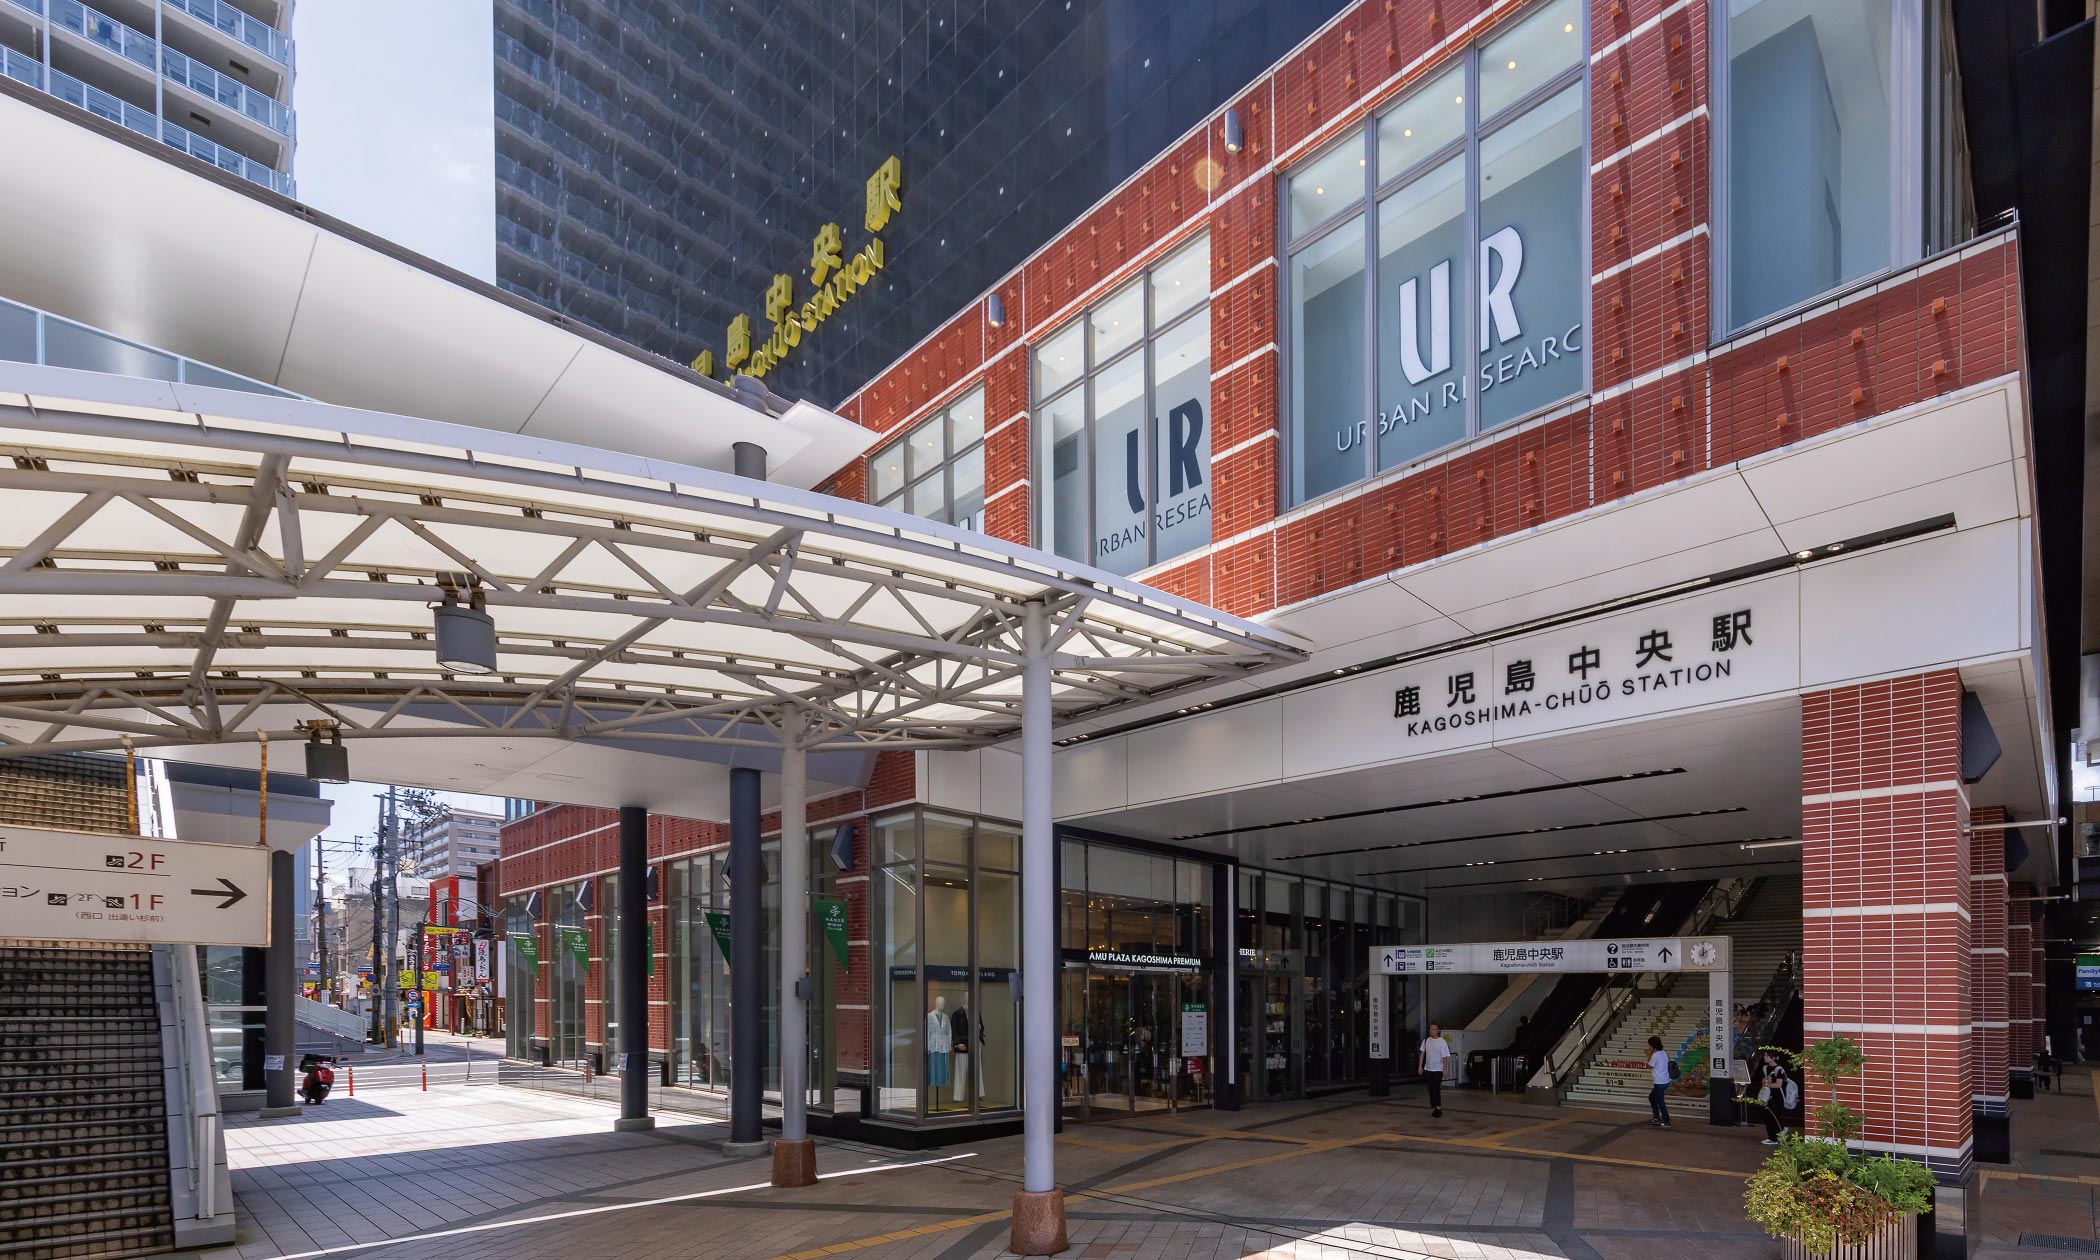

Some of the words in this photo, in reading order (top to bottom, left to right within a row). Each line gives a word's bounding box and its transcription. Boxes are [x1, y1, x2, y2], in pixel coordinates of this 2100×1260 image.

[800, 237, 884, 332] STATION
[1399, 225, 1523, 385] UR
[1442, 323, 1582, 408] RSEARC
[1096, 521, 1146, 557] RBAN
[1393, 609, 1753, 719] 鹿児島中央駅
[1407, 681, 1611, 737] KAGOSHIMA-CHŪŌ
[1622, 659, 1732, 695] STATION
[127, 852, 165, 870] 2F
[78, 893, 94, 902] 2F
[130, 893, 164, 910] 1F
[1089, 952, 1107, 961] AMU
[1108, 953, 1131, 962] PLAZA
[1131, 954, 1173, 965] KAGOSHIMA
[1173, 957, 1201, 966] PREMIUM
[1493, 947, 1564, 961] 鹿児島中央駅
